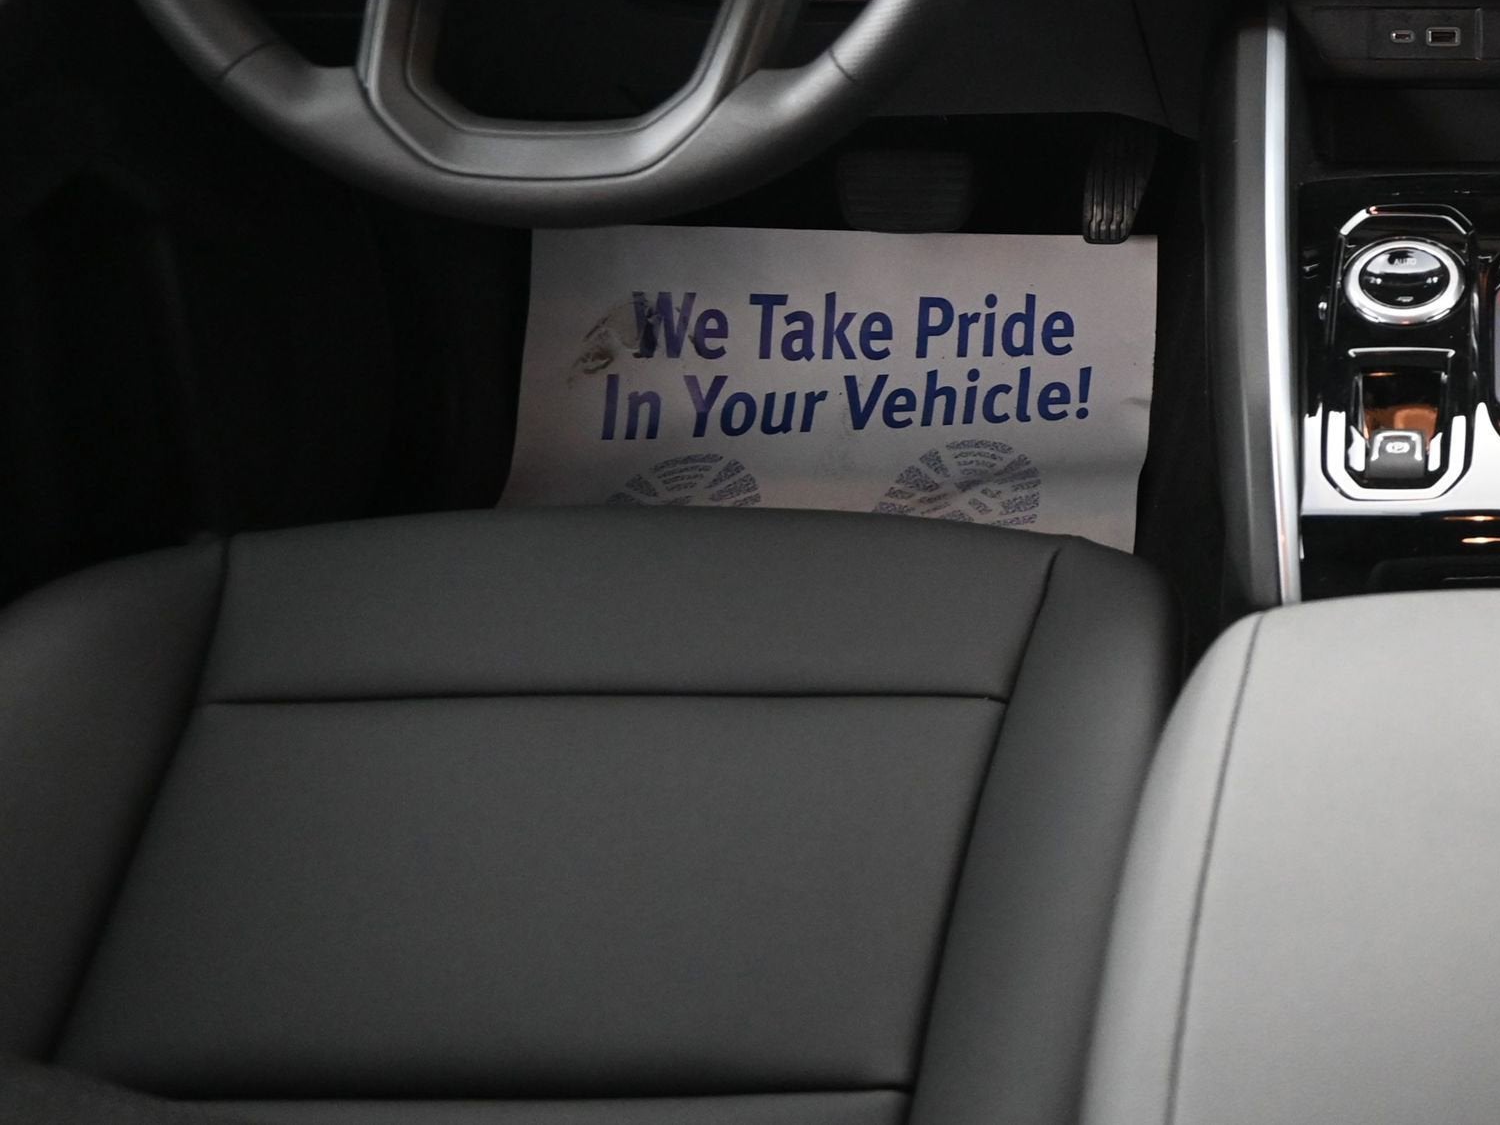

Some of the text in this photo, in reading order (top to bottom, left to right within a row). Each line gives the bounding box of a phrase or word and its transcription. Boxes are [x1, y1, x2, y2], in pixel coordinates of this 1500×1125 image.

[1393, 258, 1417, 266] AUTO
[632, 291, 1075, 360] We Take Pride
[601, 366, 1092, 440] In Your Vehicle!
